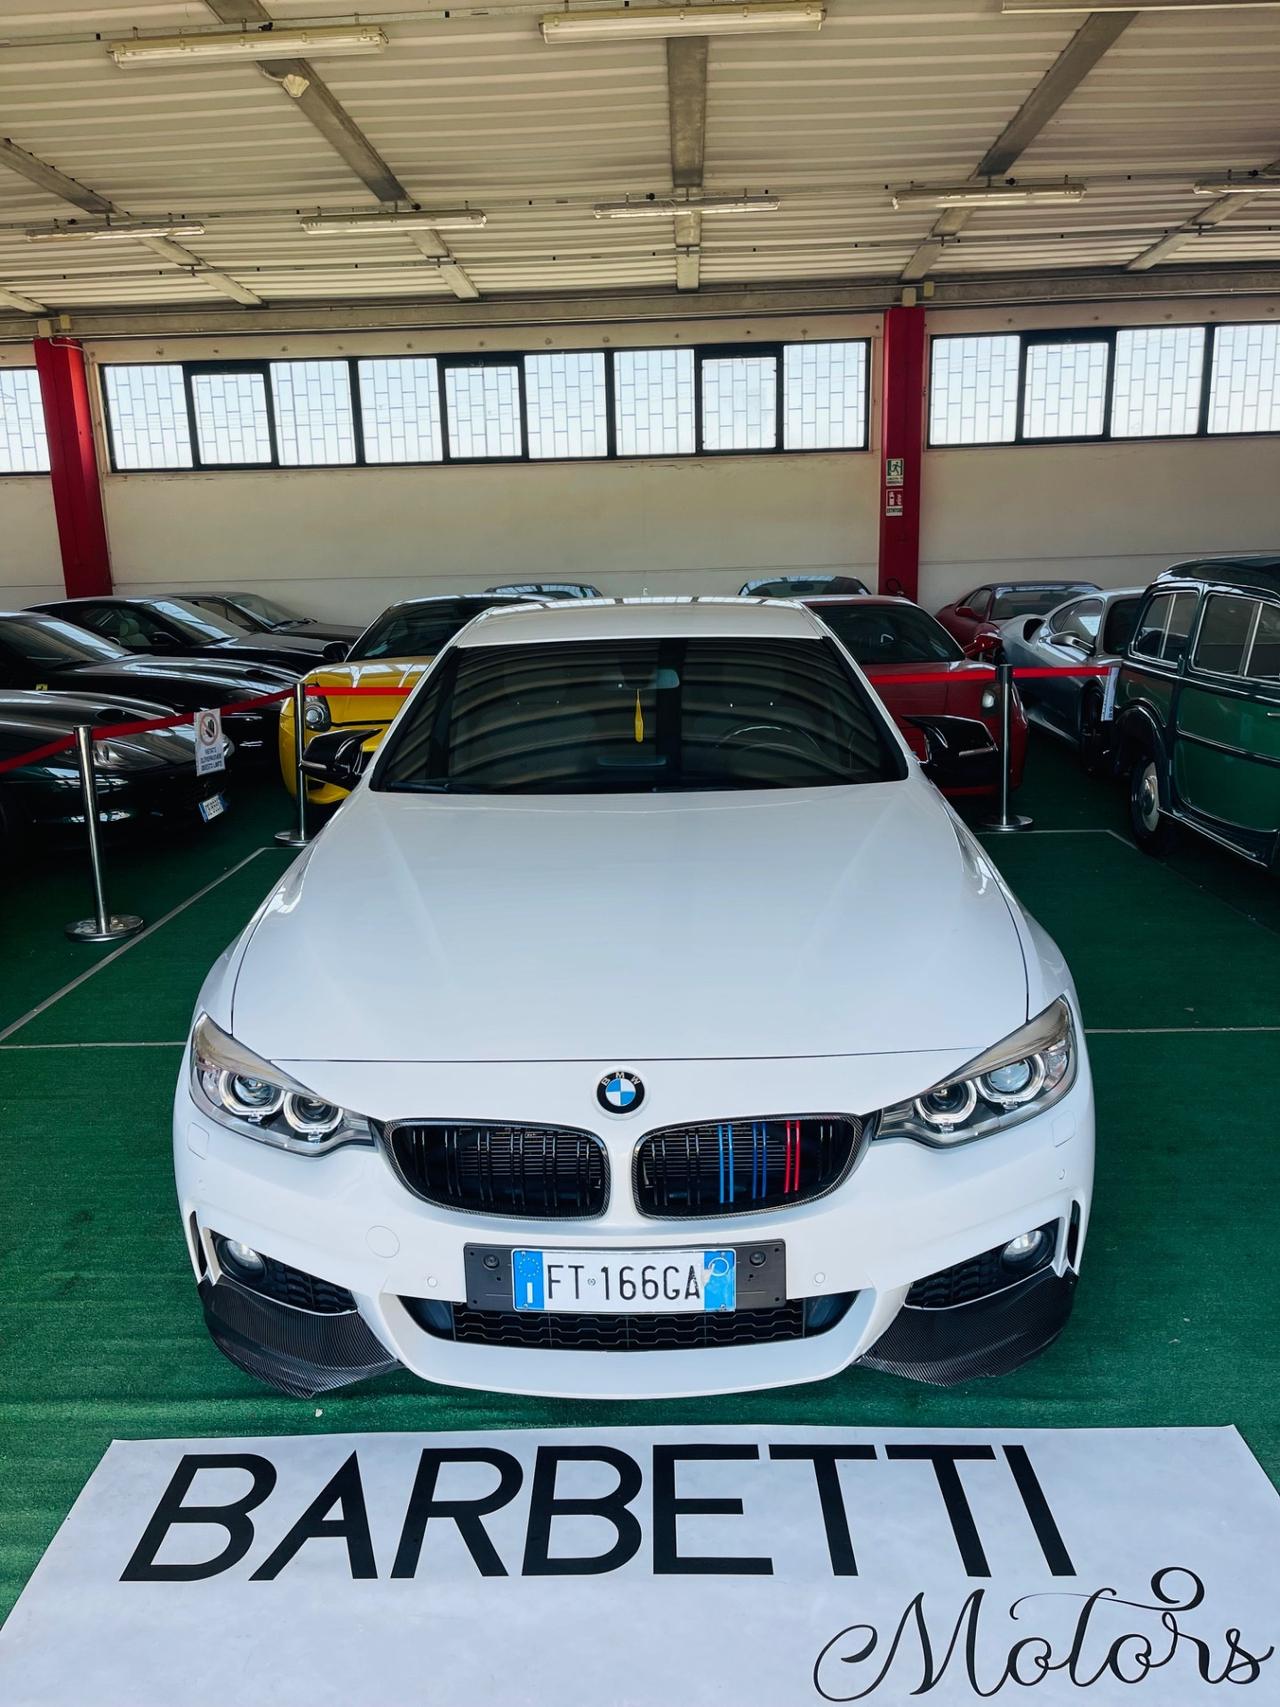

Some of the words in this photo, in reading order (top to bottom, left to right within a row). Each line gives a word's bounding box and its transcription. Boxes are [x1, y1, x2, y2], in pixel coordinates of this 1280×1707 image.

[601, 1071, 640, 1086] BMW
[547, 1265, 584, 1299] FT
[601, 1265, 700, 1301] 166GA
[119, 1443, 1078, 1582] BARBETTI
[813, 1566, 1275, 1702] Motors
